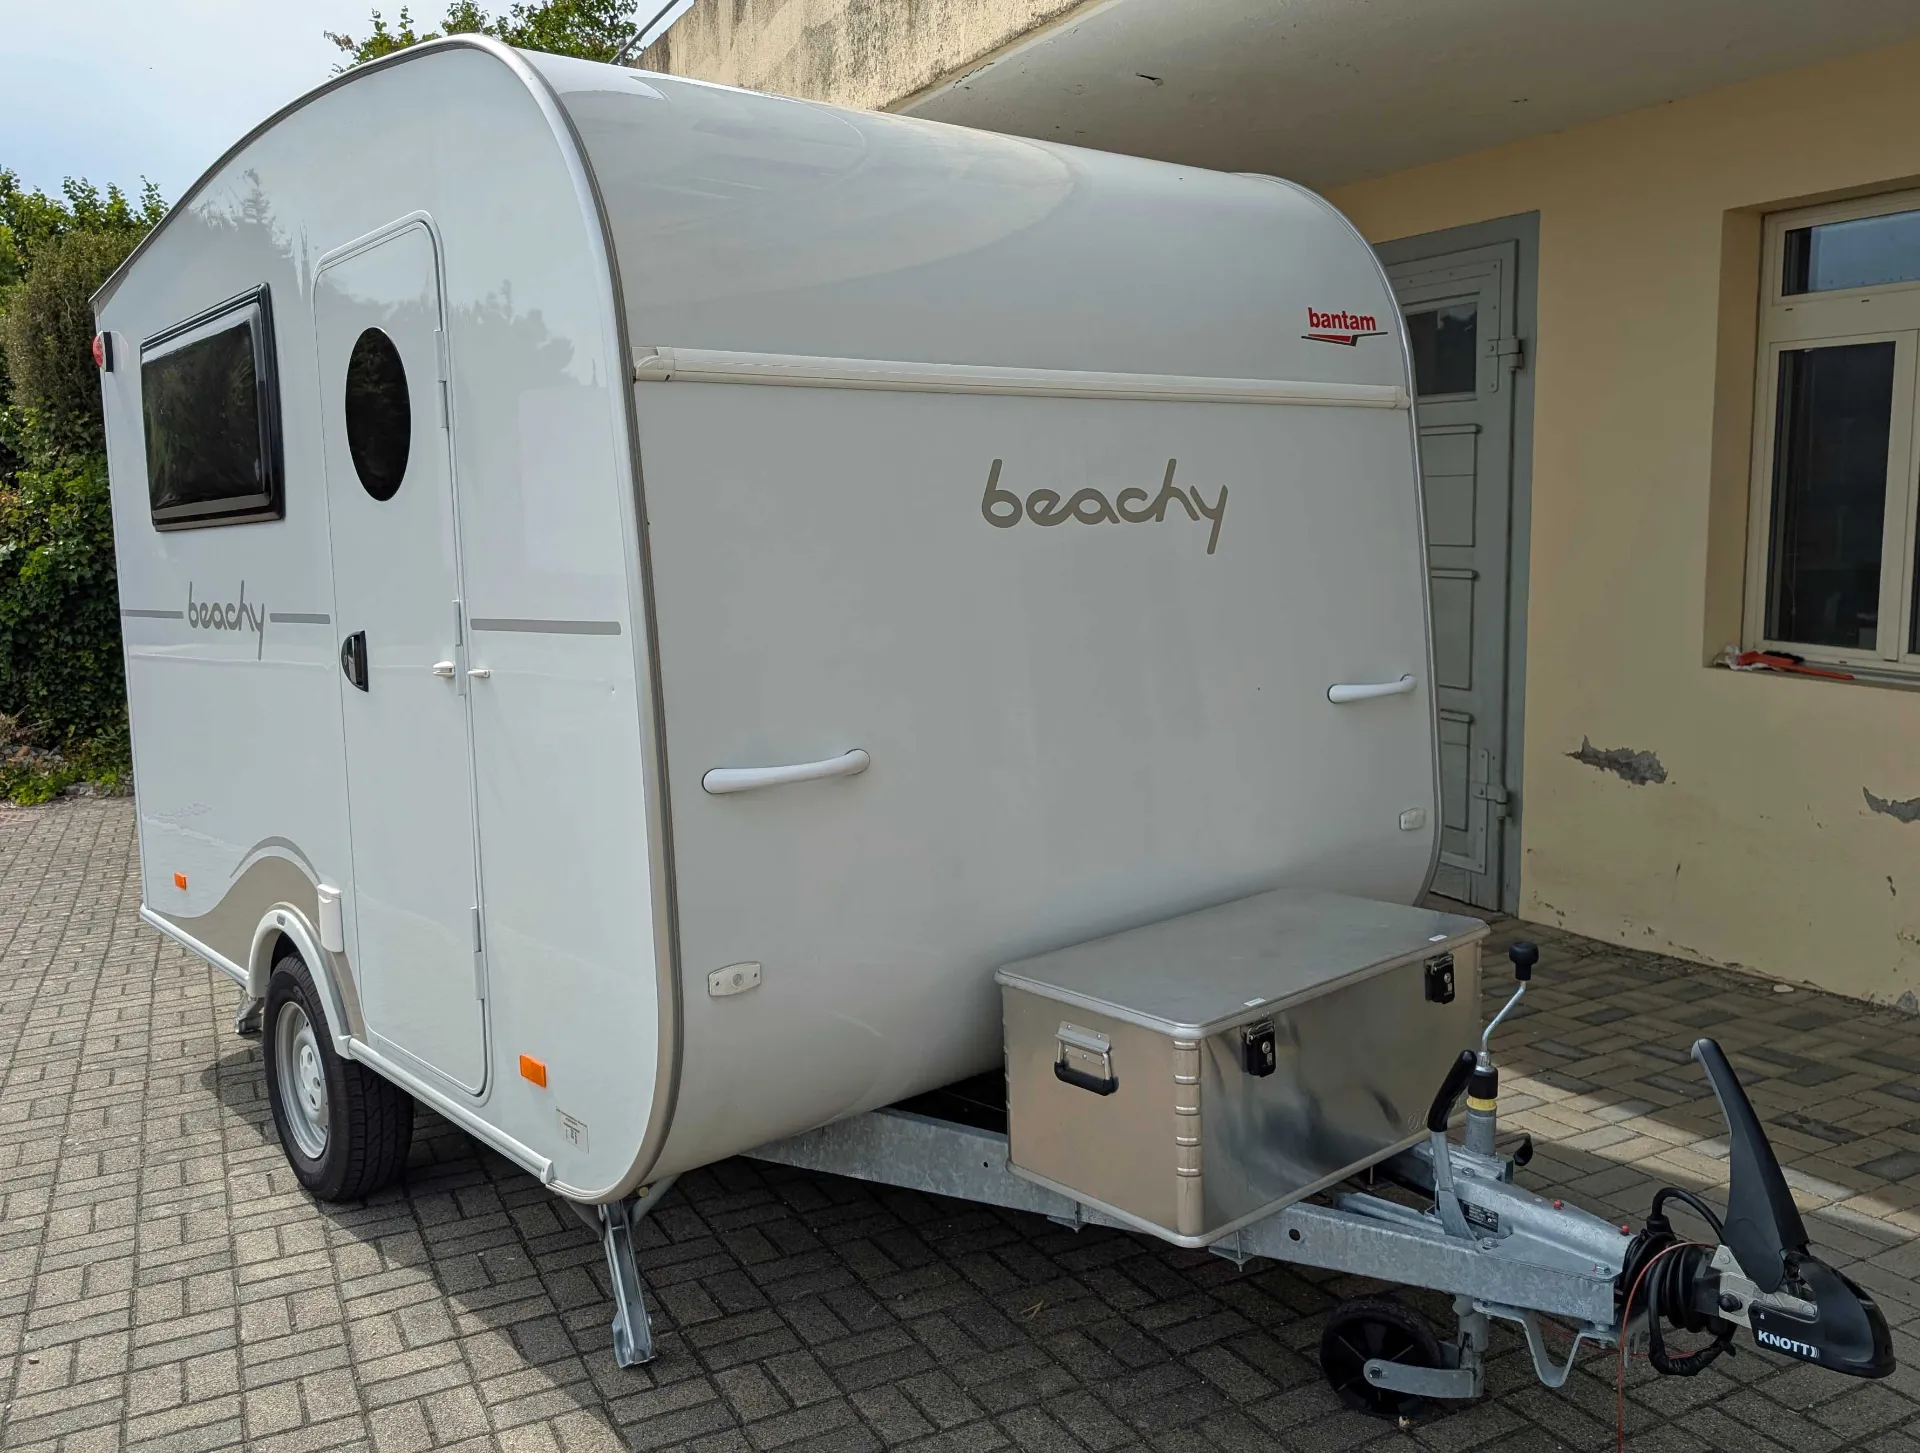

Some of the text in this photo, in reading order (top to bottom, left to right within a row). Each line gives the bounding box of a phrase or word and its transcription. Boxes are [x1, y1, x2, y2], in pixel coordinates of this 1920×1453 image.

[1308, 307, 1376, 331] bantam
[982, 458, 1228, 555] beachy
[188, 580, 264, 661] beachy
[1758, 1329, 1810, 1356] KNOTT
